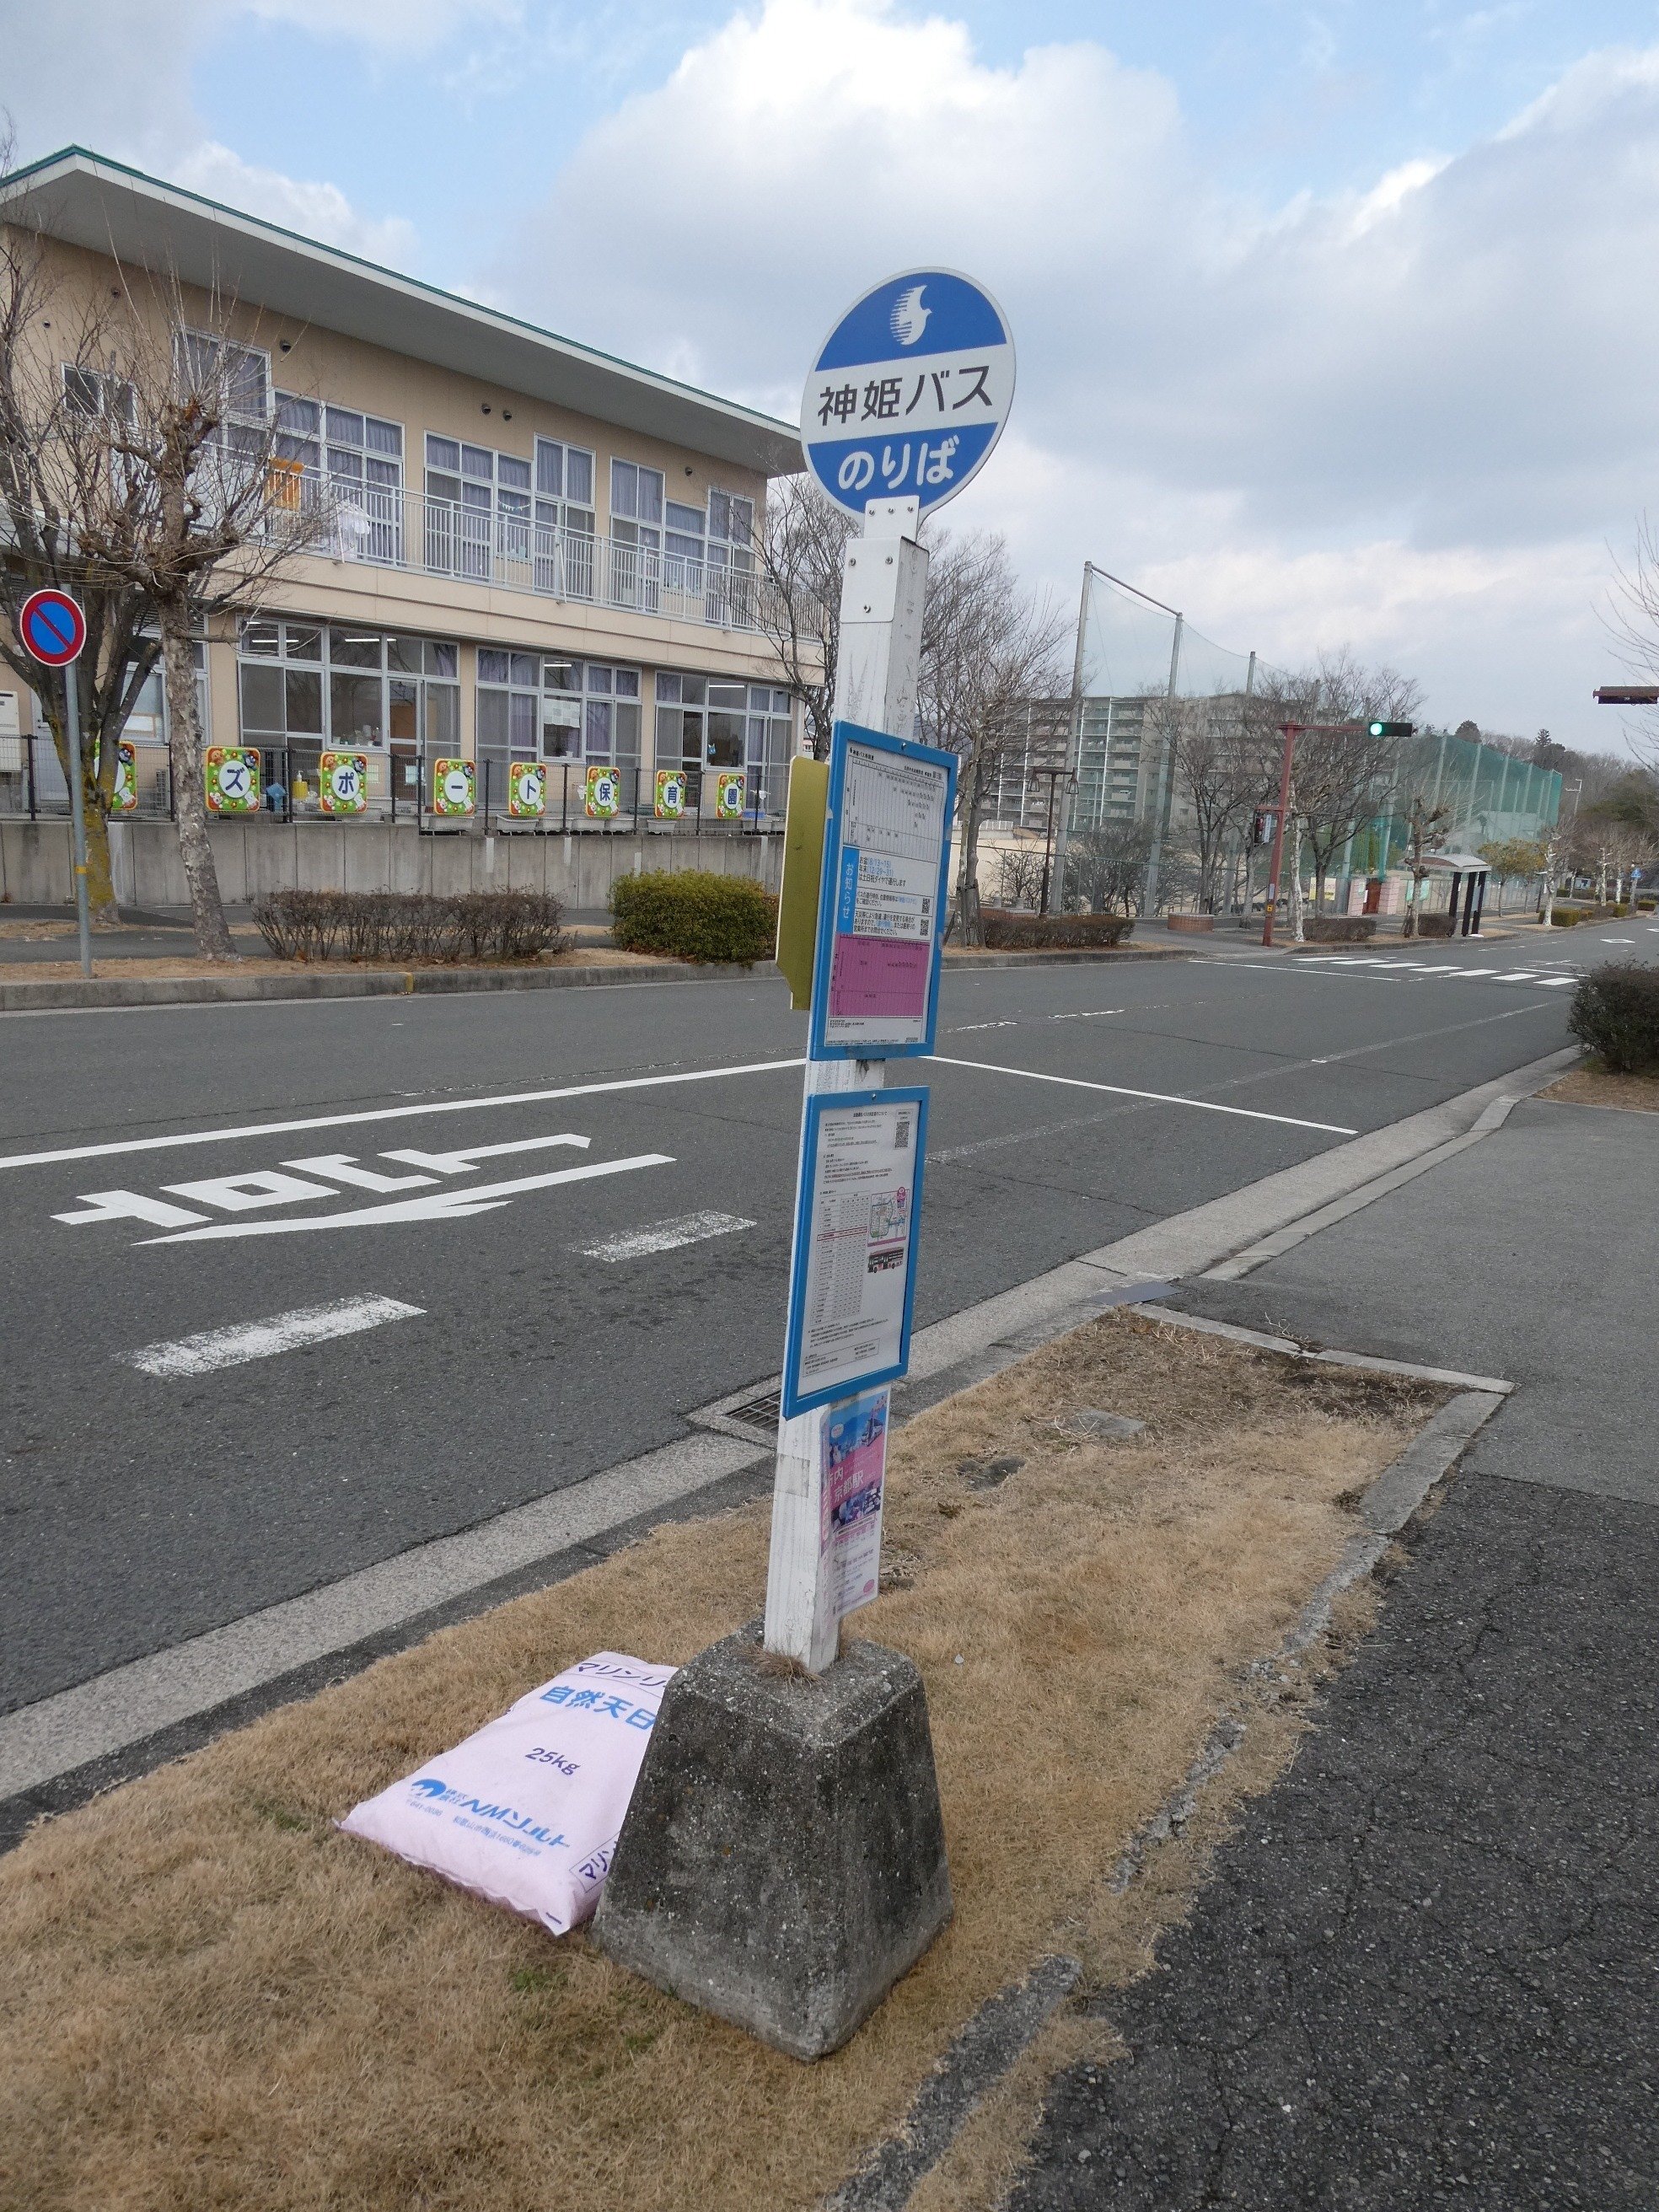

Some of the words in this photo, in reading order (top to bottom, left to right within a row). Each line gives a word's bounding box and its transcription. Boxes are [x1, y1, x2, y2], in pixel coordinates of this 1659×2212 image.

[818, 365, 993, 426] 神姫バス
[838, 434, 960, 491] のりば
[225, 767, 245, 792] ズ
[338, 773, 355, 794] ポ
[525, 780, 537, 799] ト
[599, 783, 611, 802] 保
[667, 787, 678, 804] 育
[727, 788, 738, 804] 園
[843, 862, 854, 919] お知らせ
[835, 1469, 864, 1503] 京都駅
[578, 1662, 667, 1687] マリンリ
[540, 1685, 657, 1731] 自然天日
[525, 1747, 582, 1776] 25kg
[459, 1798, 571, 1848] NMソルト
